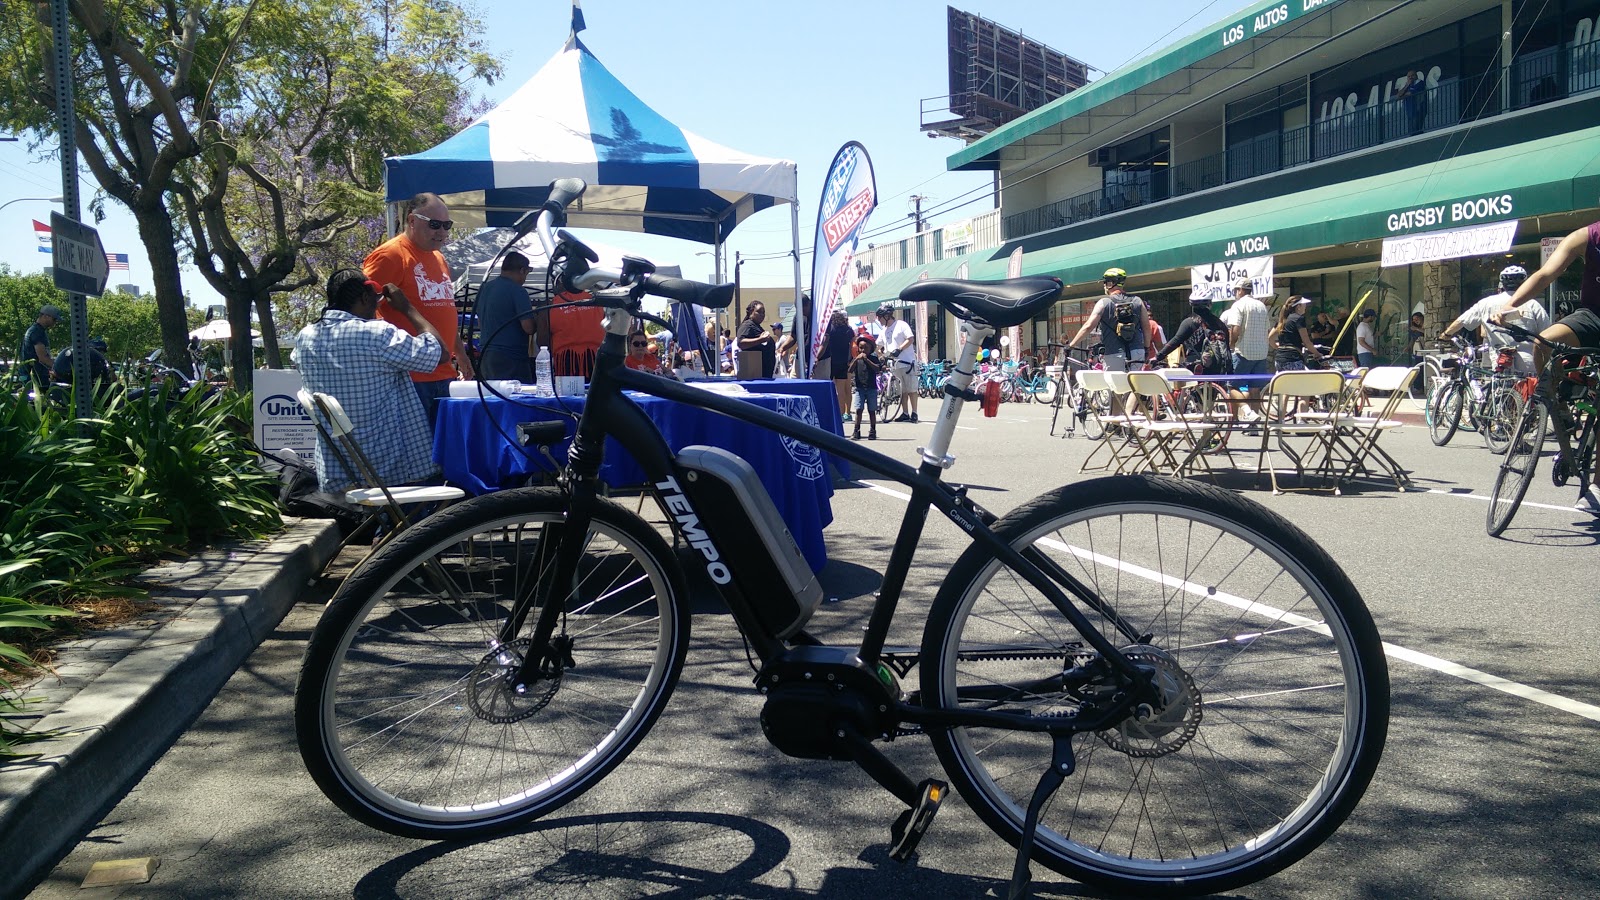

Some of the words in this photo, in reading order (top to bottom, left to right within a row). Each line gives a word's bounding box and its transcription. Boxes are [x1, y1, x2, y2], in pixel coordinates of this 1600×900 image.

[1223, 24, 1244, 46] LOS
[1254, 4, 1288, 32] ALTOS
[1365, 65, 1442, 118] ALTS
[825, 190, 872, 245] STREETS
[1387, 206, 1445, 231] GATSBY
[1452, 194, 1512, 221] BOOKS
[60, 239, 76, 270] ONE
[78, 245, 94, 275] WAY
[1224, 241, 1237, 257] JA
[1240, 236, 1270, 254] YOGA
[1204, 263, 1220, 282] Ja
[1224, 261, 1248, 282] Yoga
[655, 474, 732, 585] TEMPO
[949, 509, 975, 531] Carmel
